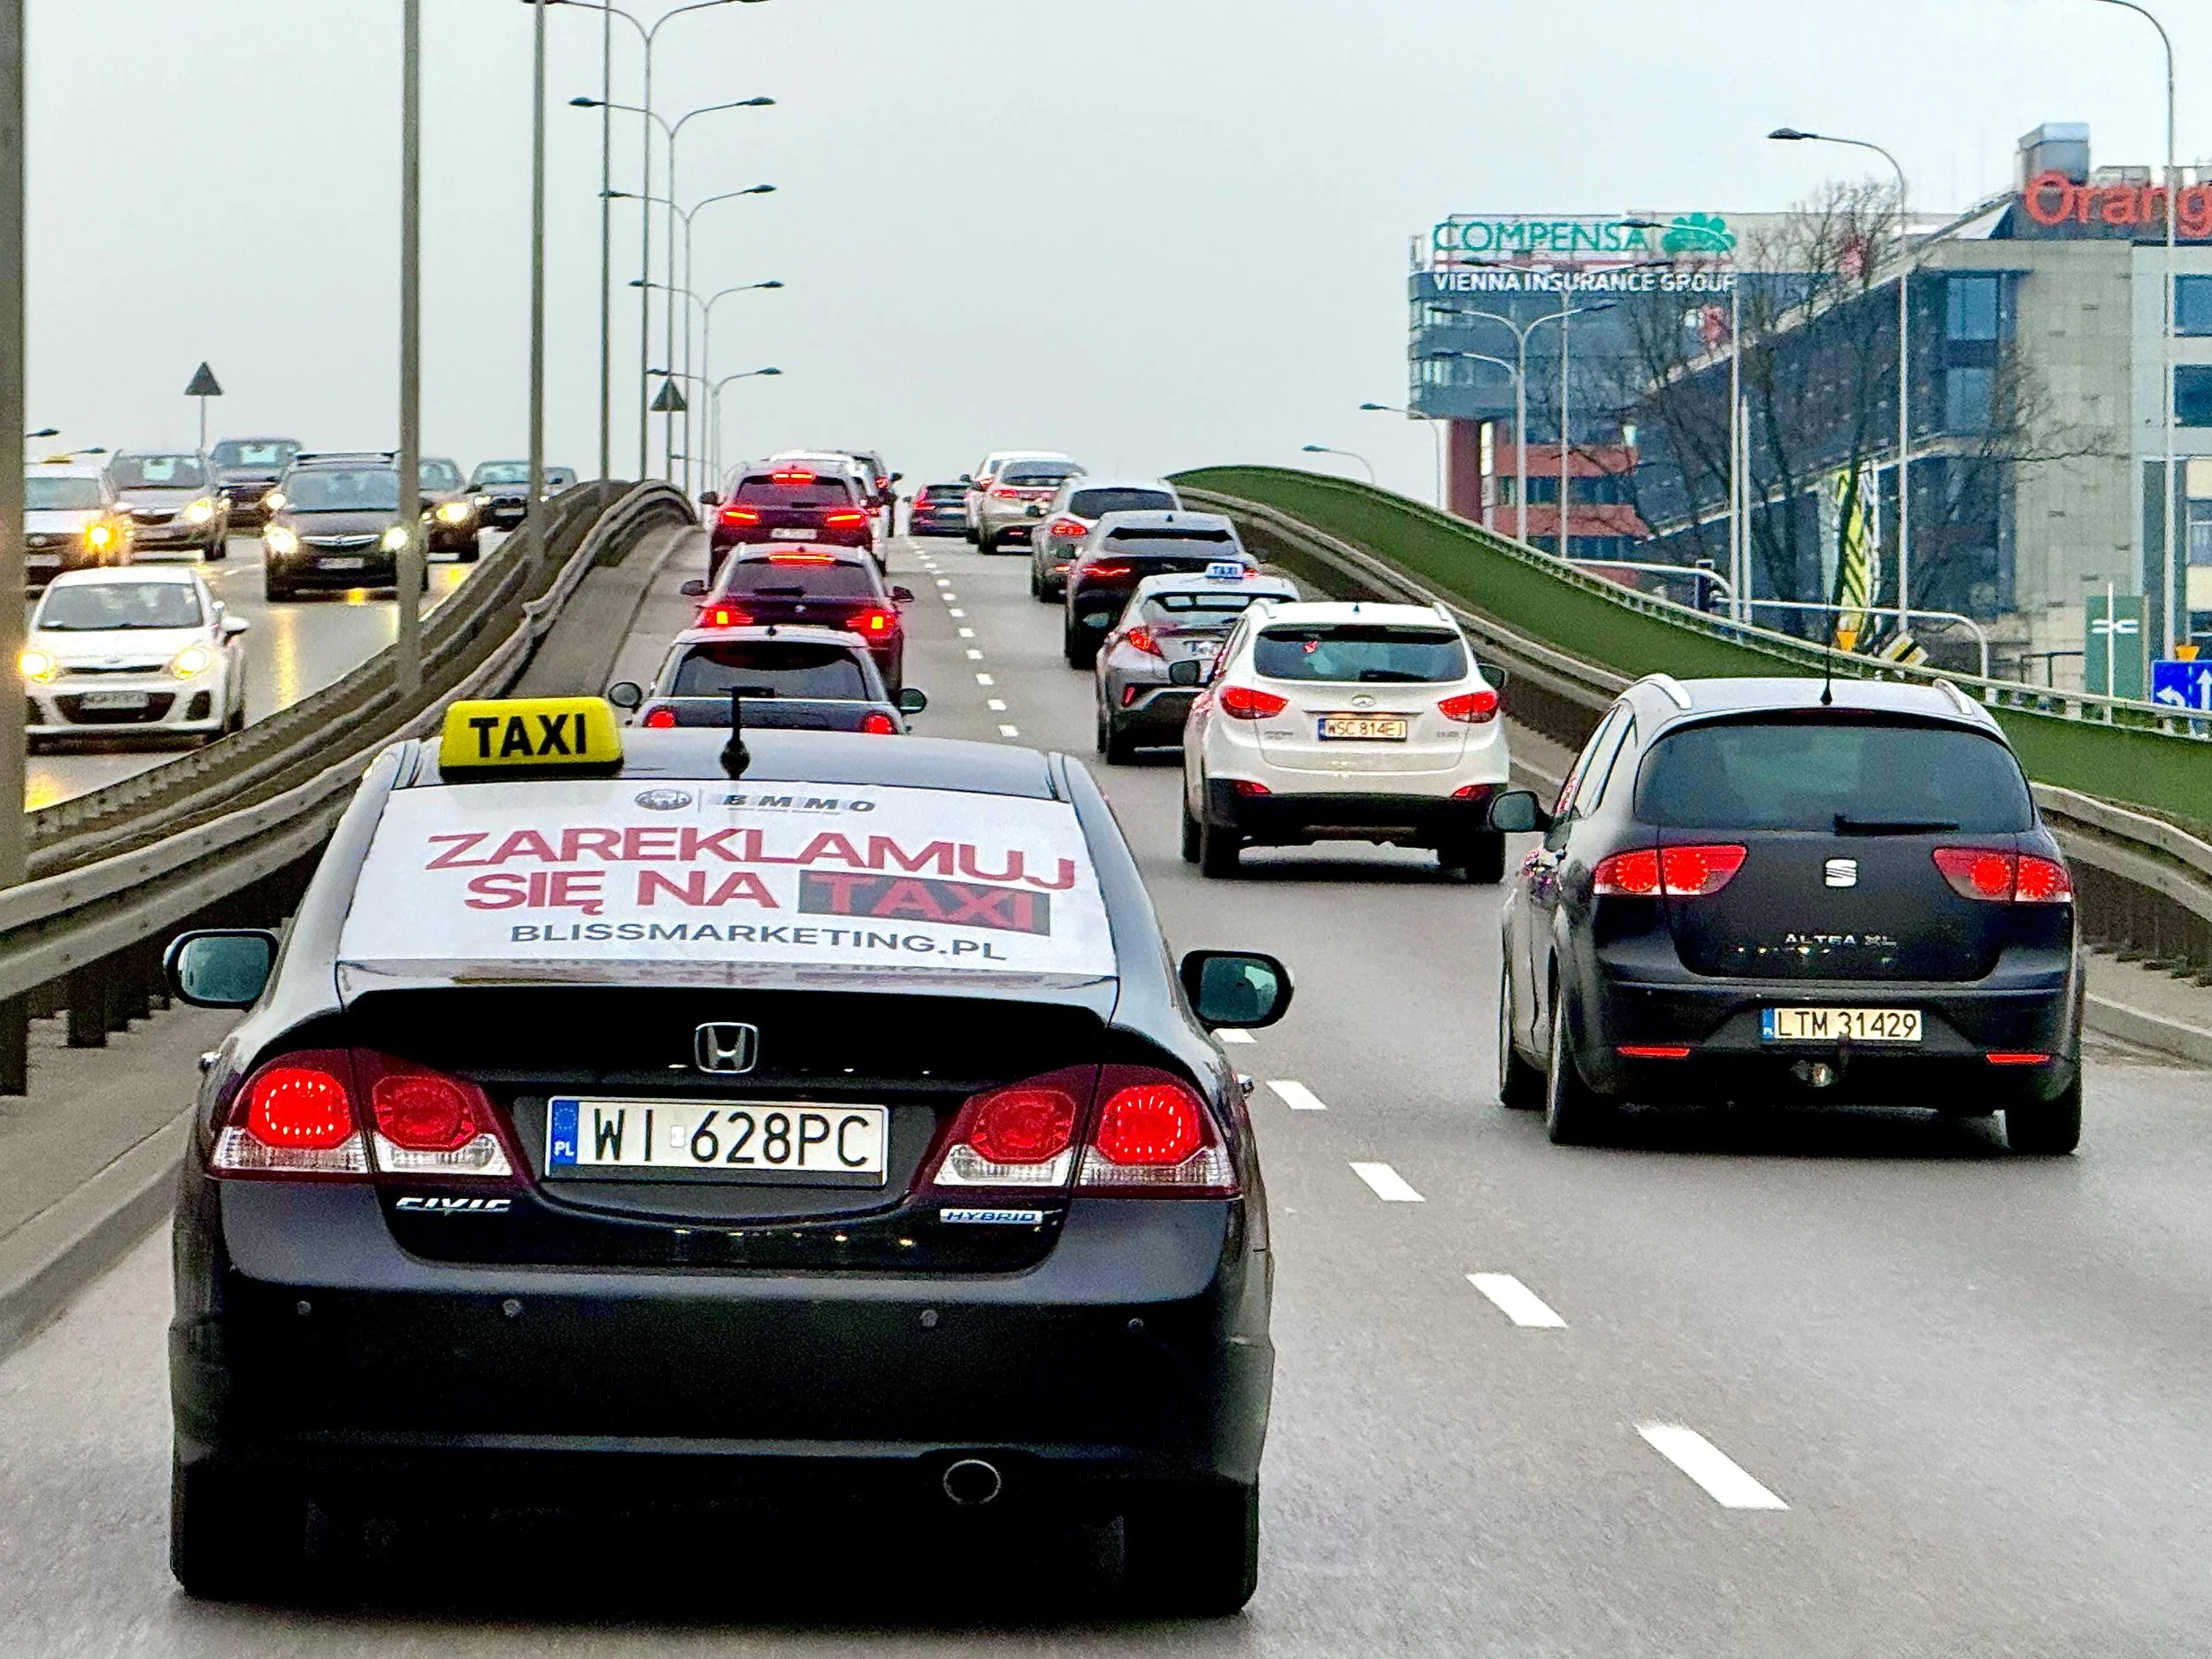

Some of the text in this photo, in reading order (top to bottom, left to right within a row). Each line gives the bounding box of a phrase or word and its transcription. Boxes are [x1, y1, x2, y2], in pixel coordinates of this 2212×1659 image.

[1433, 221, 1650, 251] COMPENSA
[1433, 273, 1521, 291] VIENNA
[1525, 273, 1655, 292] INSURANCE
[469, 713, 587, 758] TAXI
[1327, 721, 1402, 736] WSC 814EJ
[723, 795, 876, 812] BMMO
[425, 826, 1075, 890] ZAREKLAMUJ
[464, 869, 1034, 931] SIĘ NA TAXI
[511, 923, 1007, 961] BLISSMARKETING.PL
[1778, 1011, 1917, 1038] LTM 31429
[553, 1142, 574, 1157] PL
[594, 1108, 870, 1167] WI 628PC
[396, 1197, 511, 1212] CIVIC
[947, 1211, 1035, 1222] HYBRID
